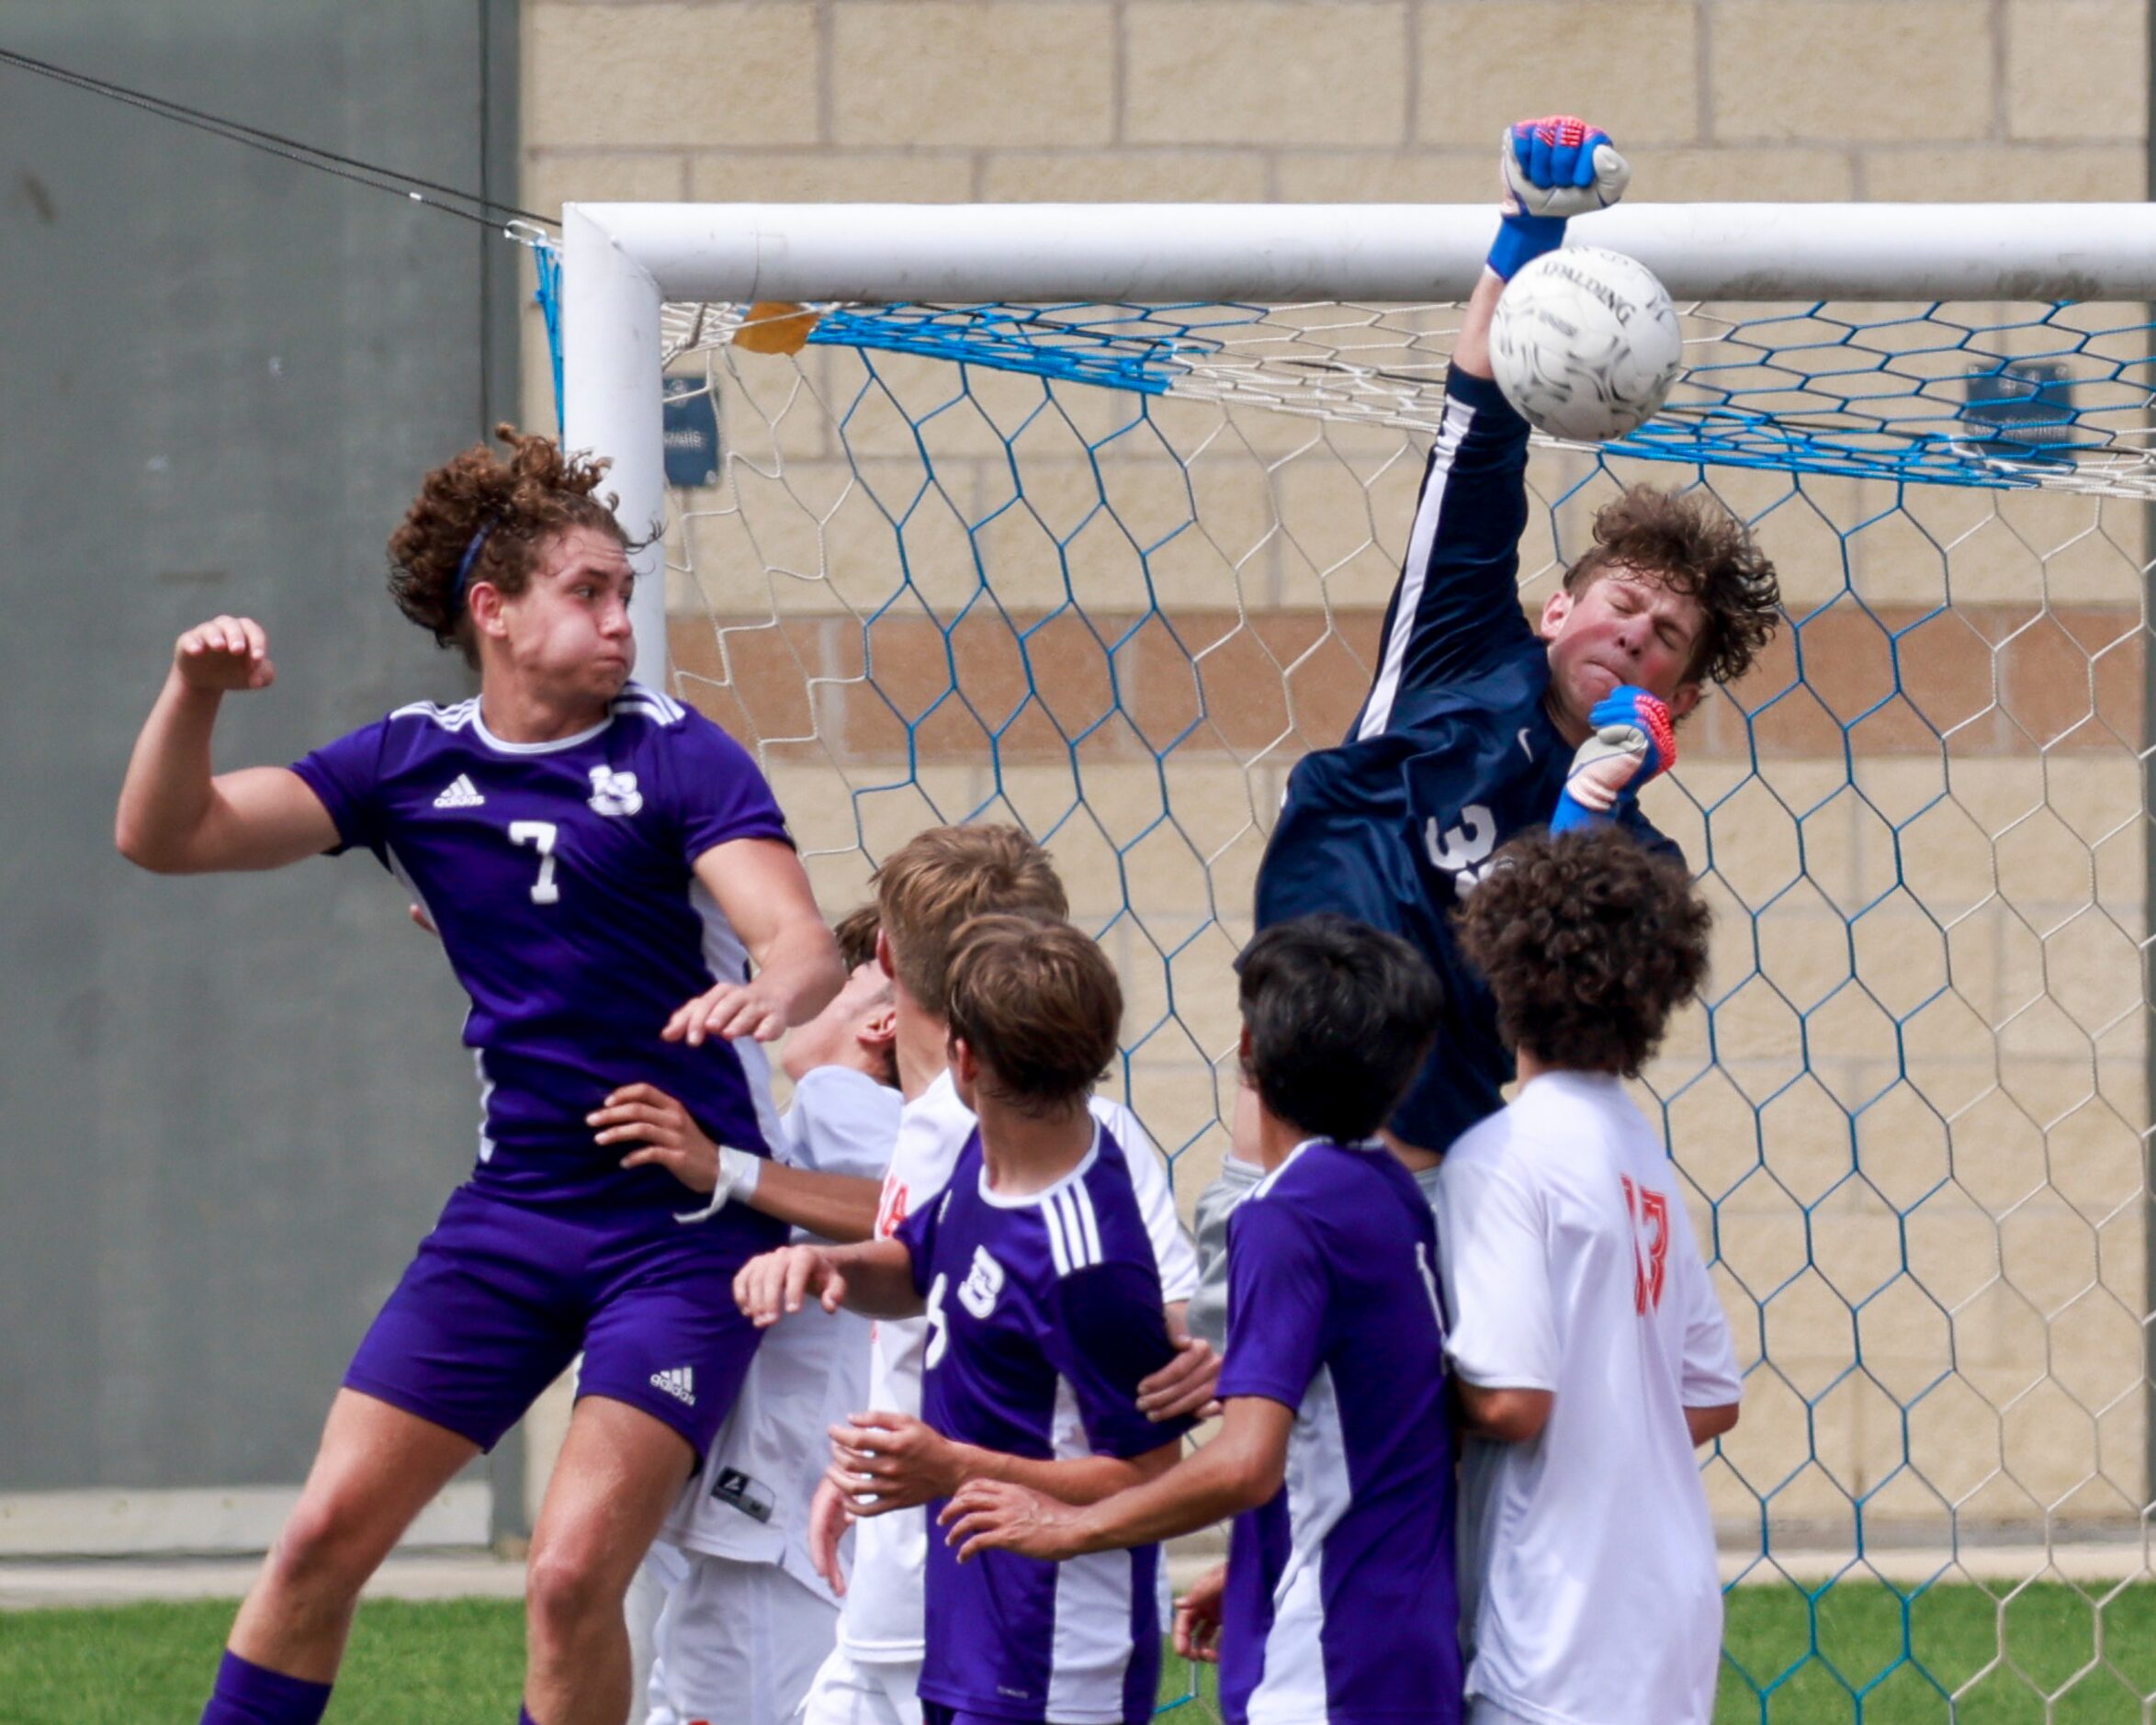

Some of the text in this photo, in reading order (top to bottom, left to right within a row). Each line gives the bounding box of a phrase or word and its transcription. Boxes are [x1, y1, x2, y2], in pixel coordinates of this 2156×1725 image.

[1538, 261, 1637, 329] PALDING
[433, 795, 485, 808] adidas
[508, 820, 559, 905] 7
[1620, 1172, 1670, 1318] 13
[649, 1373, 696, 1406] adidas
